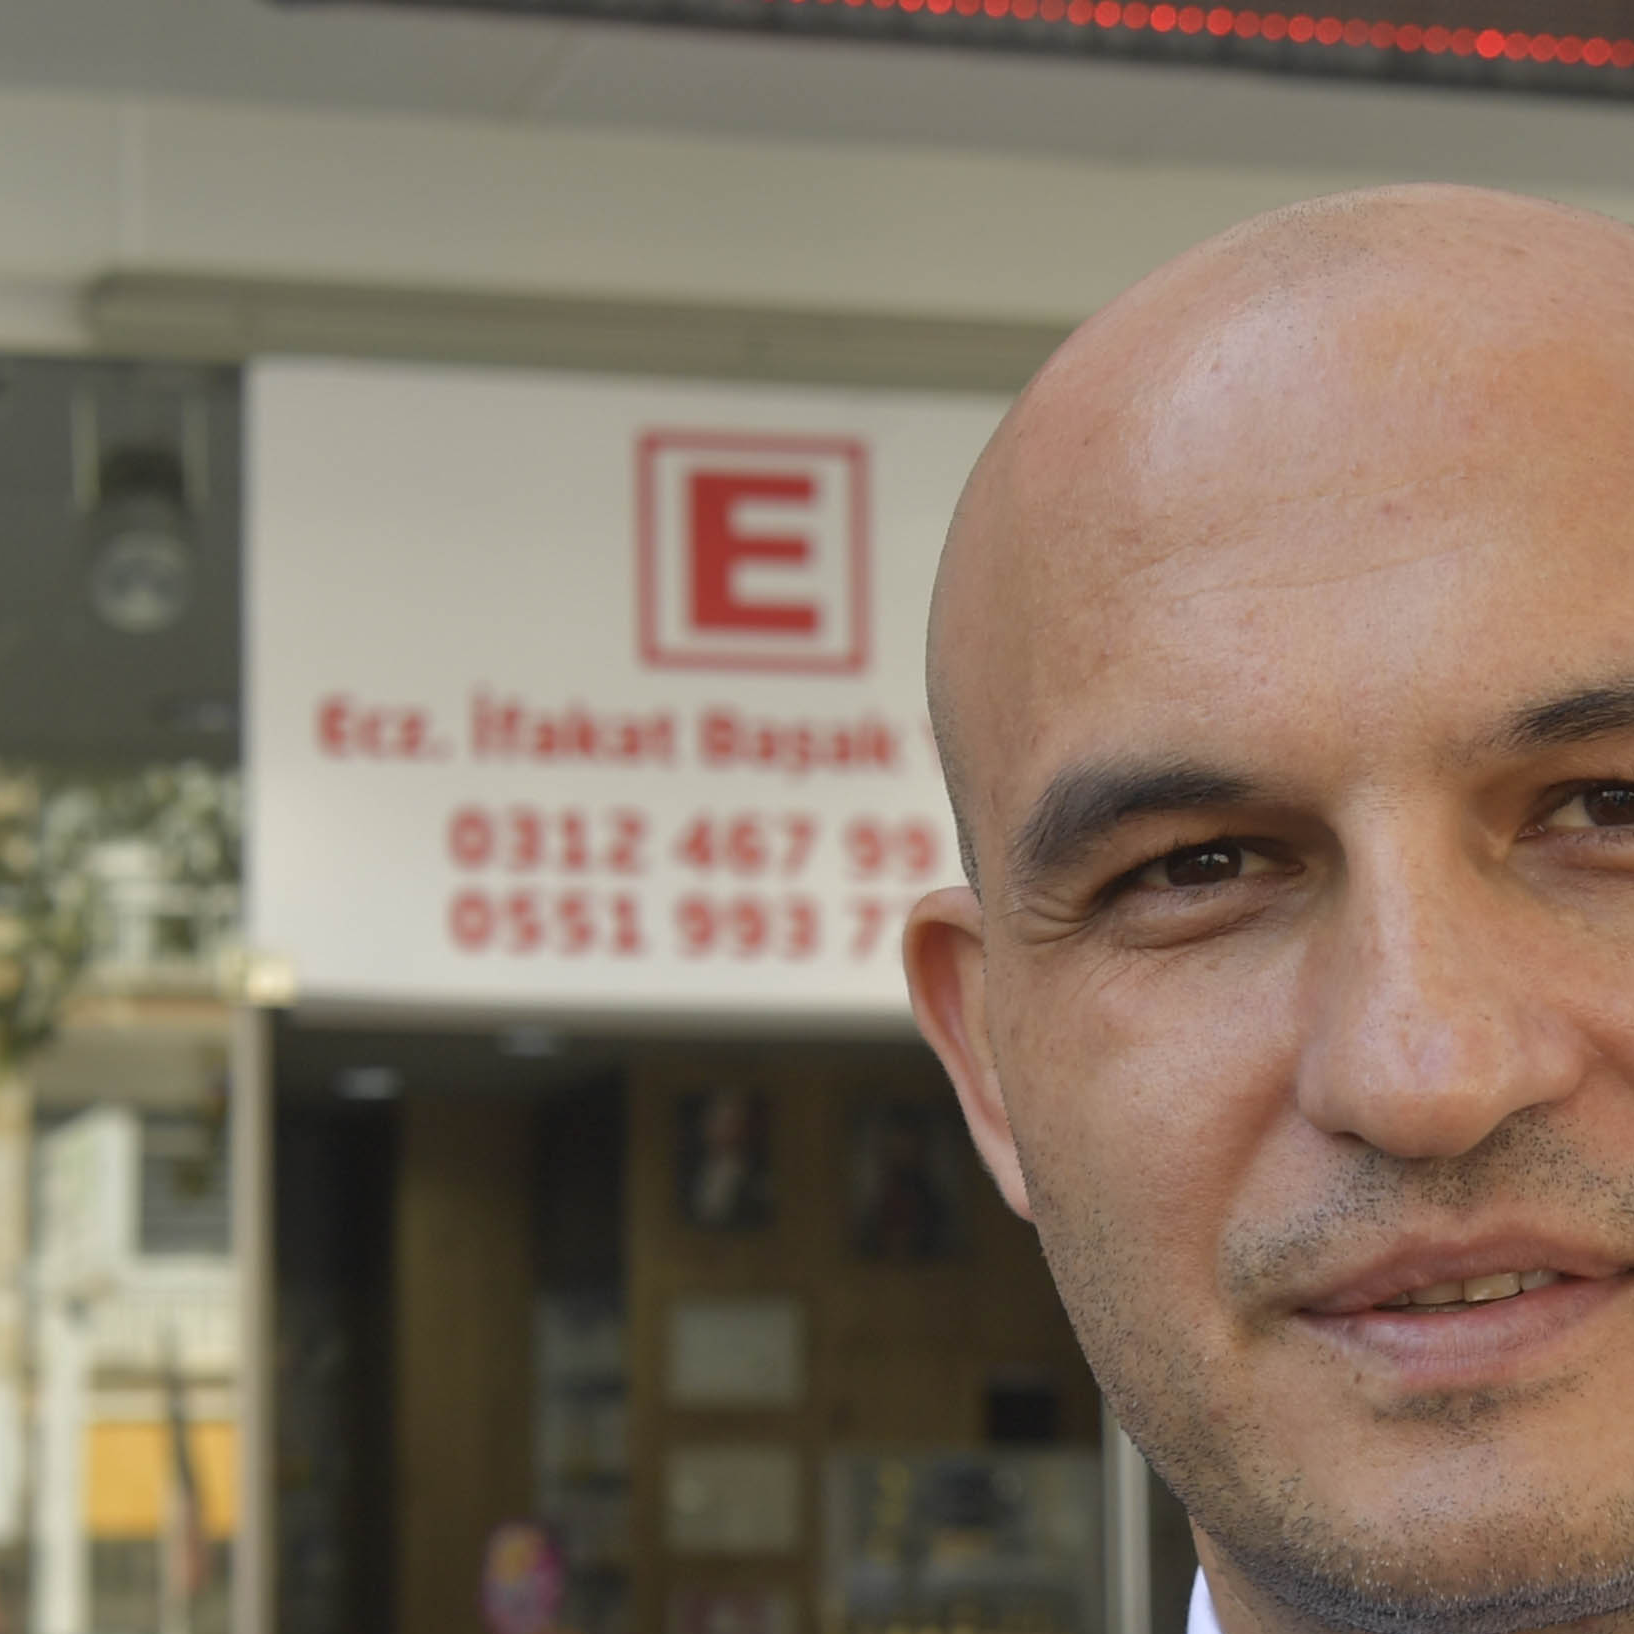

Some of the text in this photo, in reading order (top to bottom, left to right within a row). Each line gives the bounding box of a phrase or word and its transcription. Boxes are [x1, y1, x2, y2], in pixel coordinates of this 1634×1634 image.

[685, 470, 820, 637] E
[699, 706, 899, 782] Başak
[447, 805, 940, 883] 0312 467 99
[447, 892, 645, 960] 0551
